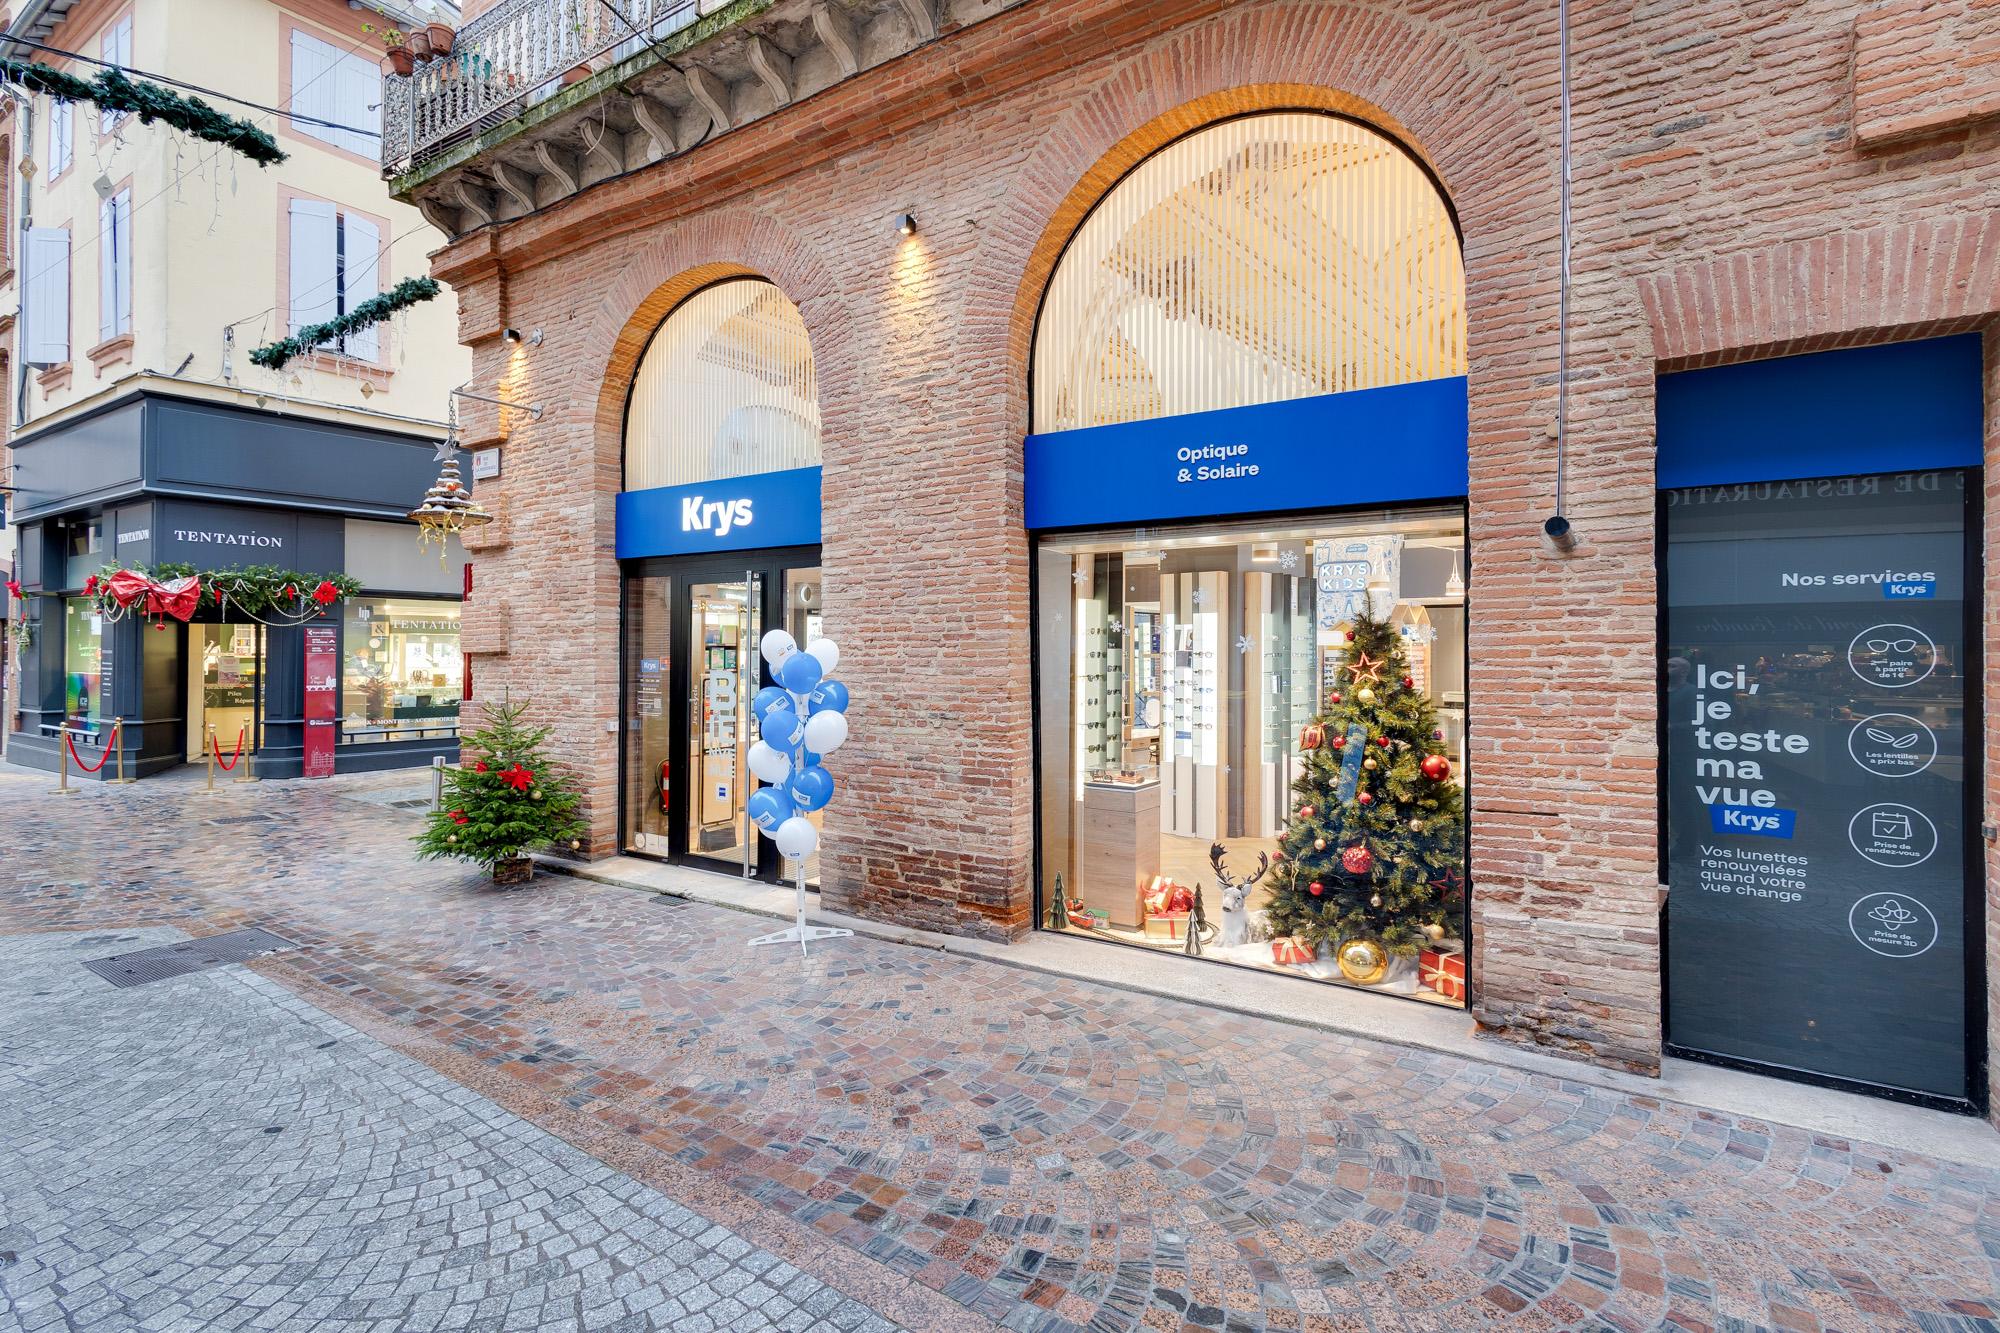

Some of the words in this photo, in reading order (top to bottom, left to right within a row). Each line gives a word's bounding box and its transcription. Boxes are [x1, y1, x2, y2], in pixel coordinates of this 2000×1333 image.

[1177, 444, 1248, 463] Optique
[1177, 468, 1192, 482] &
[1197, 463, 1260, 480] Solaire
[682, 496, 752, 536] Krys
[1321, 564, 1367, 577] KRYS
[1782, 573, 1826, 587] Nos
[1832, 570, 1936, 585] services
[1891, 584, 1927, 596] Krys
[643, 661, 657, 670] Krys
[1883, 666, 1909, 674] partir
[1697, 664, 1760, 695] Ici,
[1691, 694, 1732, 725] je
[1694, 727, 1810, 754] teste
[1883, 752, 1919, 760] lentilles
[1696, 758, 1764, 780] ma
[1695, 785, 1776, 808] vue
[1724, 809, 1781, 832] Krys
[1865, 847, 1920, 857] rendez-vous
[1874, 841, 1897, 849] Prise
[1700, 844, 1732, 858] Vos
[1736, 848, 1808, 866] lunettes
[1700, 859, 1807, 878] renouvelées
[1700, 870, 1755, 884] quand
[1759, 876, 1806, 890] votre
[1700, 882, 1731, 893] vue
[1735, 885, 1802, 903] change
[1868, 937, 1902, 945] mesure
[1874, 930, 1898, 939] Prise
